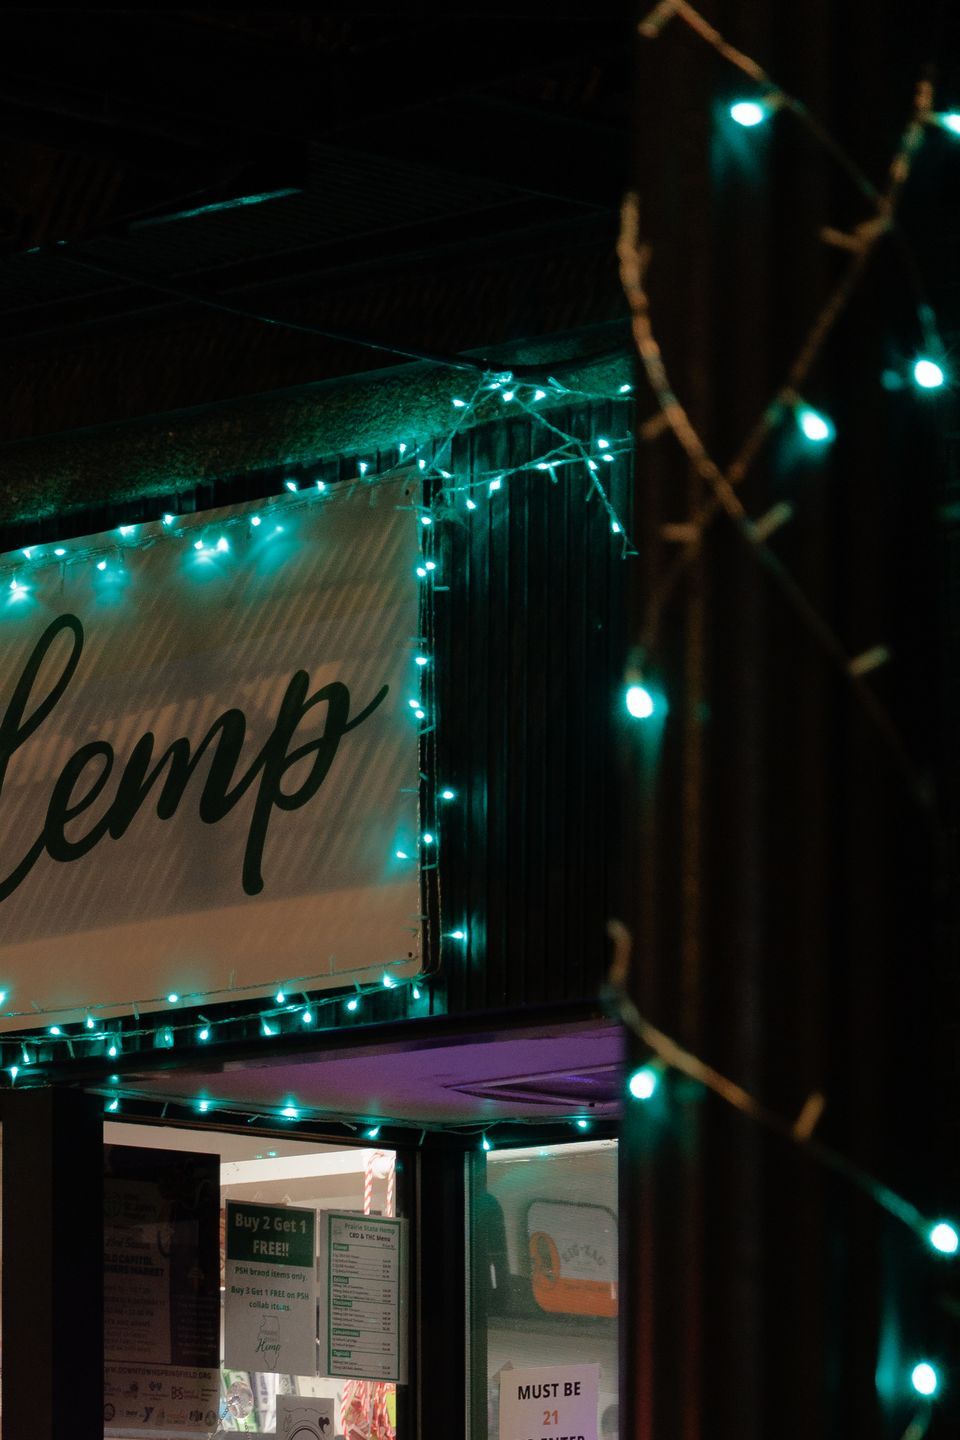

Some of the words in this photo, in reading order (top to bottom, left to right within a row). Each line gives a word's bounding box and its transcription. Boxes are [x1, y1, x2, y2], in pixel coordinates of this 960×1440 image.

[235, 1212, 260, 1233] Buy
[263, 1216, 271, 1230] 2
[273, 1217, 297, 1233] Get
[300, 1219, 307, 1234] 1
[253, 1239, 289, 1257] FREE!!
[235, 1266, 248, 1276] PSH
[249, 1268, 270, 1278] brand
[271, 1270, 290, 1280] items
[291, 1271, 308, 1282] only.
[231, 1286, 244, 1296] Buy
[245, 1286, 250, 1295] 3
[251, 1288, 263, 1296] Get
[270, 1289, 285, 1298] FREE
[296, 1292, 309, 1301] PSH
[518, 1383, 559, 1400] MUST
[564, 1381, 581, 1397] BE
[543, 1410, 559, 1425] 21
